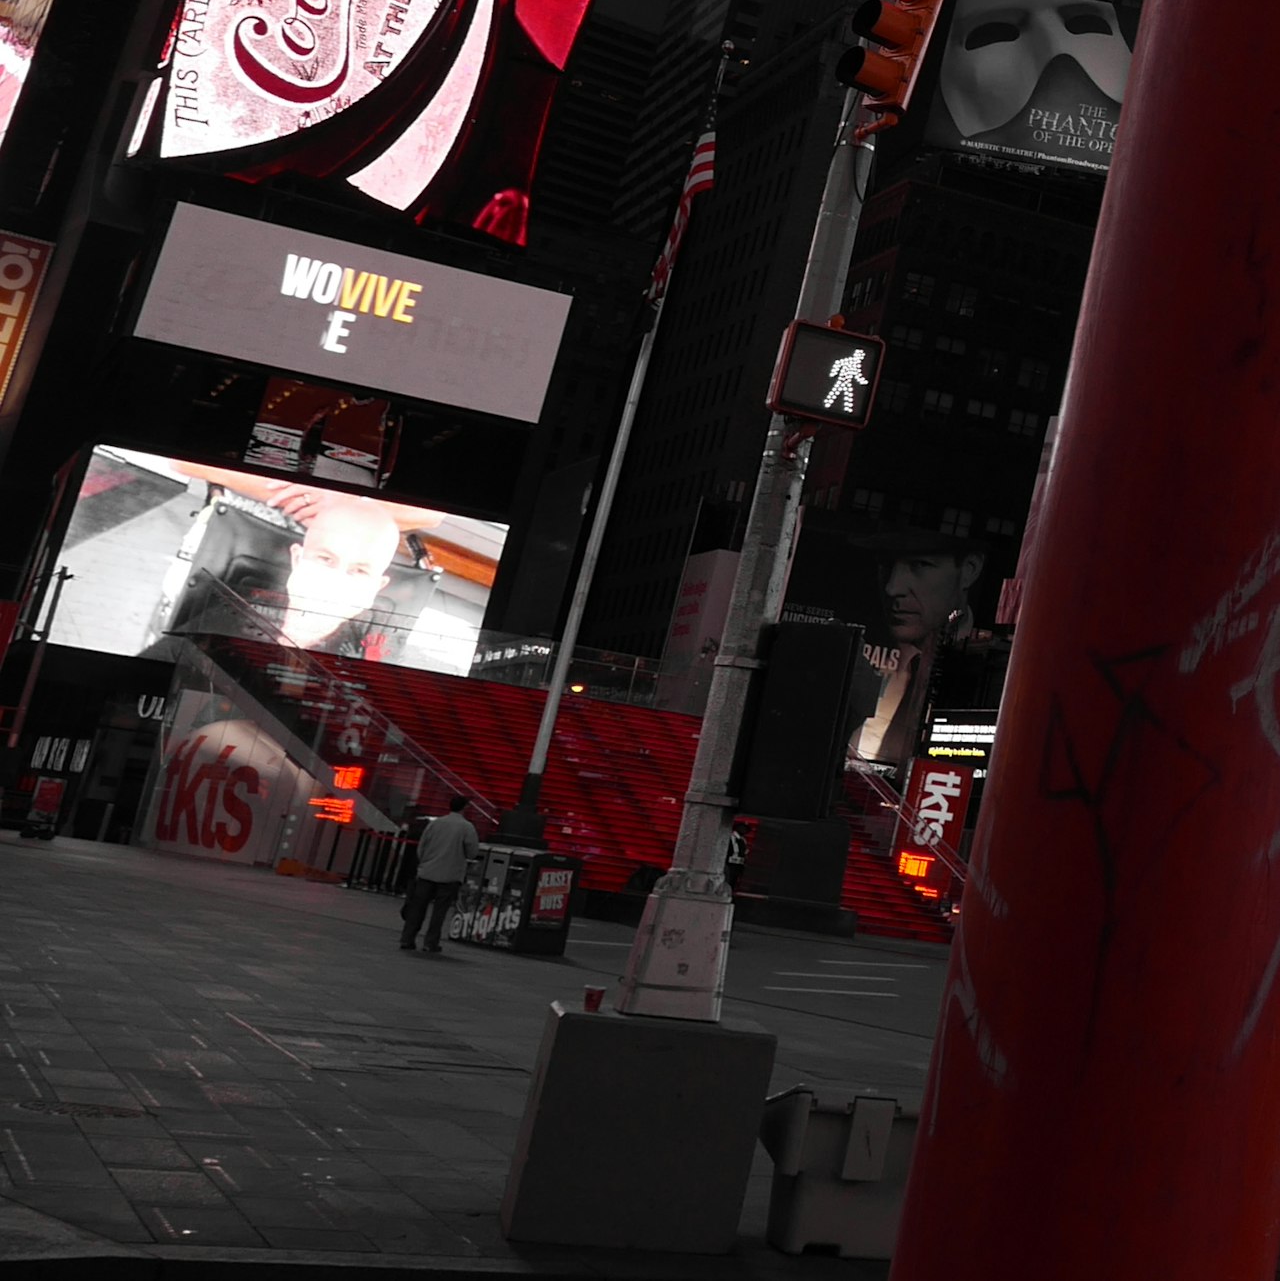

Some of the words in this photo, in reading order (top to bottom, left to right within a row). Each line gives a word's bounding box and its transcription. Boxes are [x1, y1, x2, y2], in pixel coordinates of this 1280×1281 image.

[353, 14, 371, 52] Trade
[172, 68, 214, 130] THIS
[1079, 103, 1108, 119] THE
[1033, 129, 1053, 144] OF
[1058, 132, 1086, 150] THE
[155, 733, 261, 854] tkts
[912, 771, 961, 846] tkts
